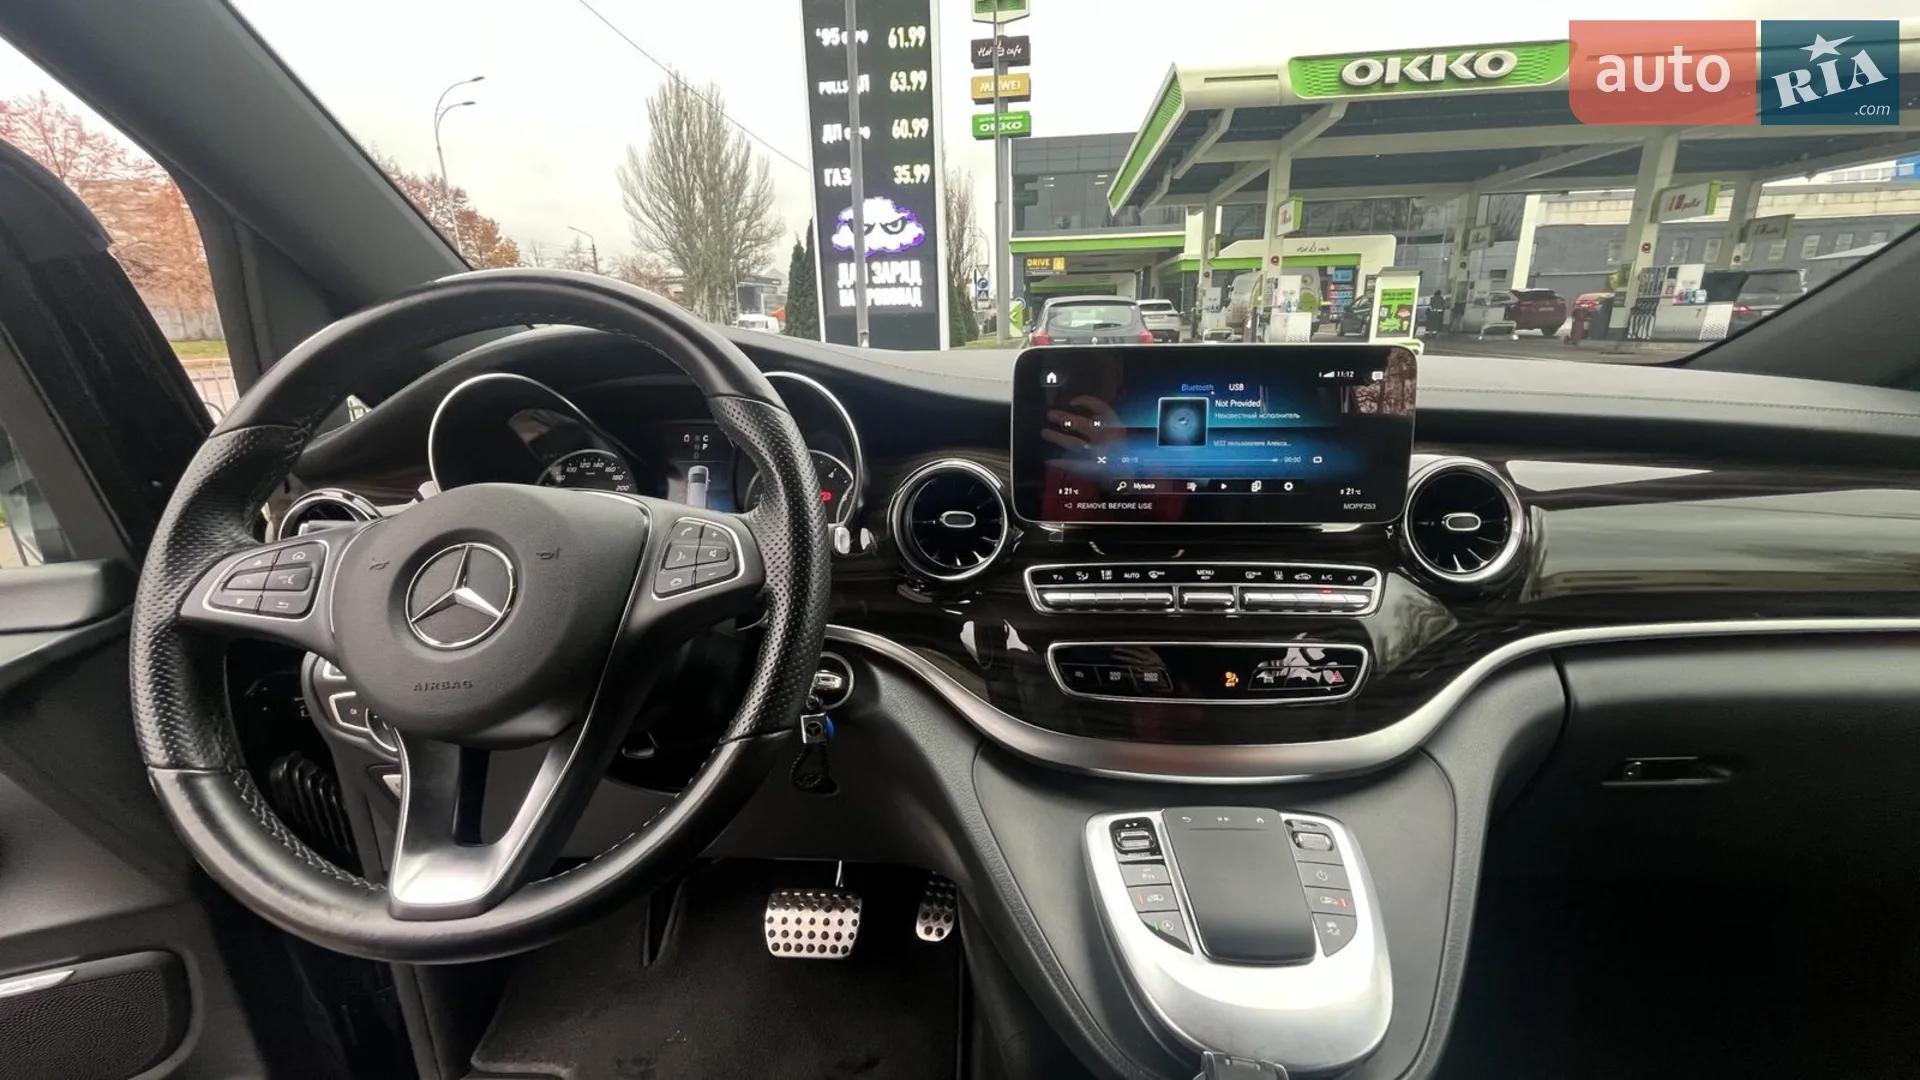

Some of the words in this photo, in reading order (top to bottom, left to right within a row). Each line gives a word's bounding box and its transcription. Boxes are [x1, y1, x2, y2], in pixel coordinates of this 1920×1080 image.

[888, 25, 926, 48] 61.99
[1006, 44, 1022, 57] cafe
[1341, 50, 1518, 87] OKKO
[889, 70, 927, 93] 63.99
[892, 117, 929, 139] 60.99
[823, 167, 852, 187] ГАЗ
[893, 163, 931, 185] 35.99
[1026, 258, 1050, 267] DRIVE
[1181, 384, 1214, 392] Bluetooth
[1228, 383, 1244, 392] USB
[1215, 399, 1228, 408] Not
[1230, 399, 1261, 408] Provided
[1258, 412, 1300, 420] исполнитель
[1133, 482, 1156, 491] Музыка
[1076, 502, 1107, 510] REMOVE
[1108, 502, 1137, 510] BEFORE
[1138, 502, 1152, 510] USE
[413, 680, 474, 692] AIRBAG
